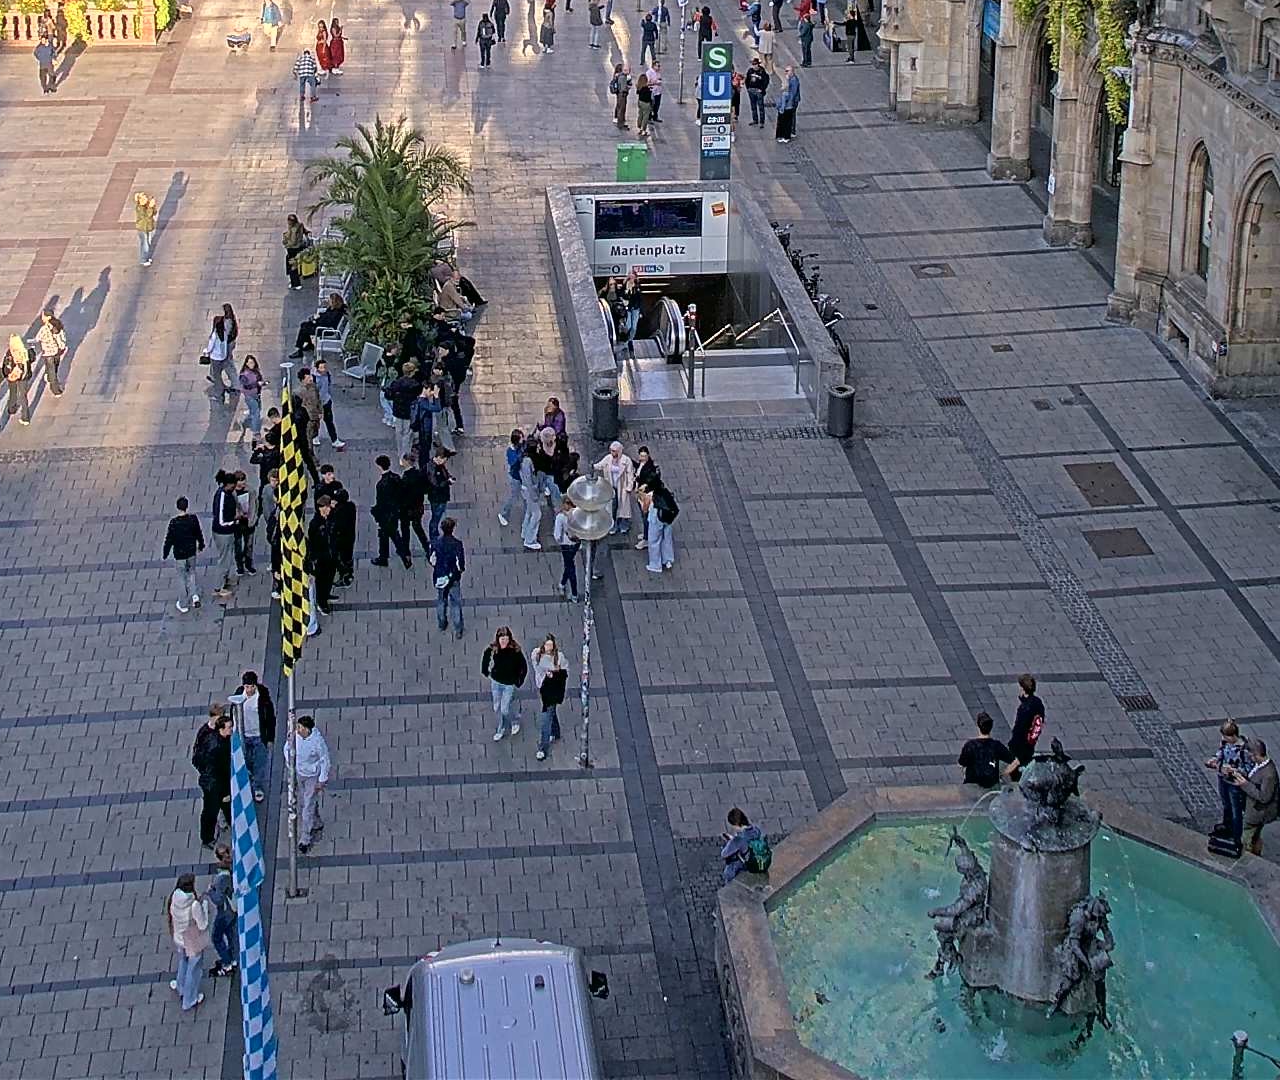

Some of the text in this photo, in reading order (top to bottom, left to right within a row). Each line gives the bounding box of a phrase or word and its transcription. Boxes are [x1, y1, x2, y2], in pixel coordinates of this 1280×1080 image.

[708, 47, 727, 69] S
[708, 75, 726, 97] U
[610, 243, 686, 258] Marienplatz
